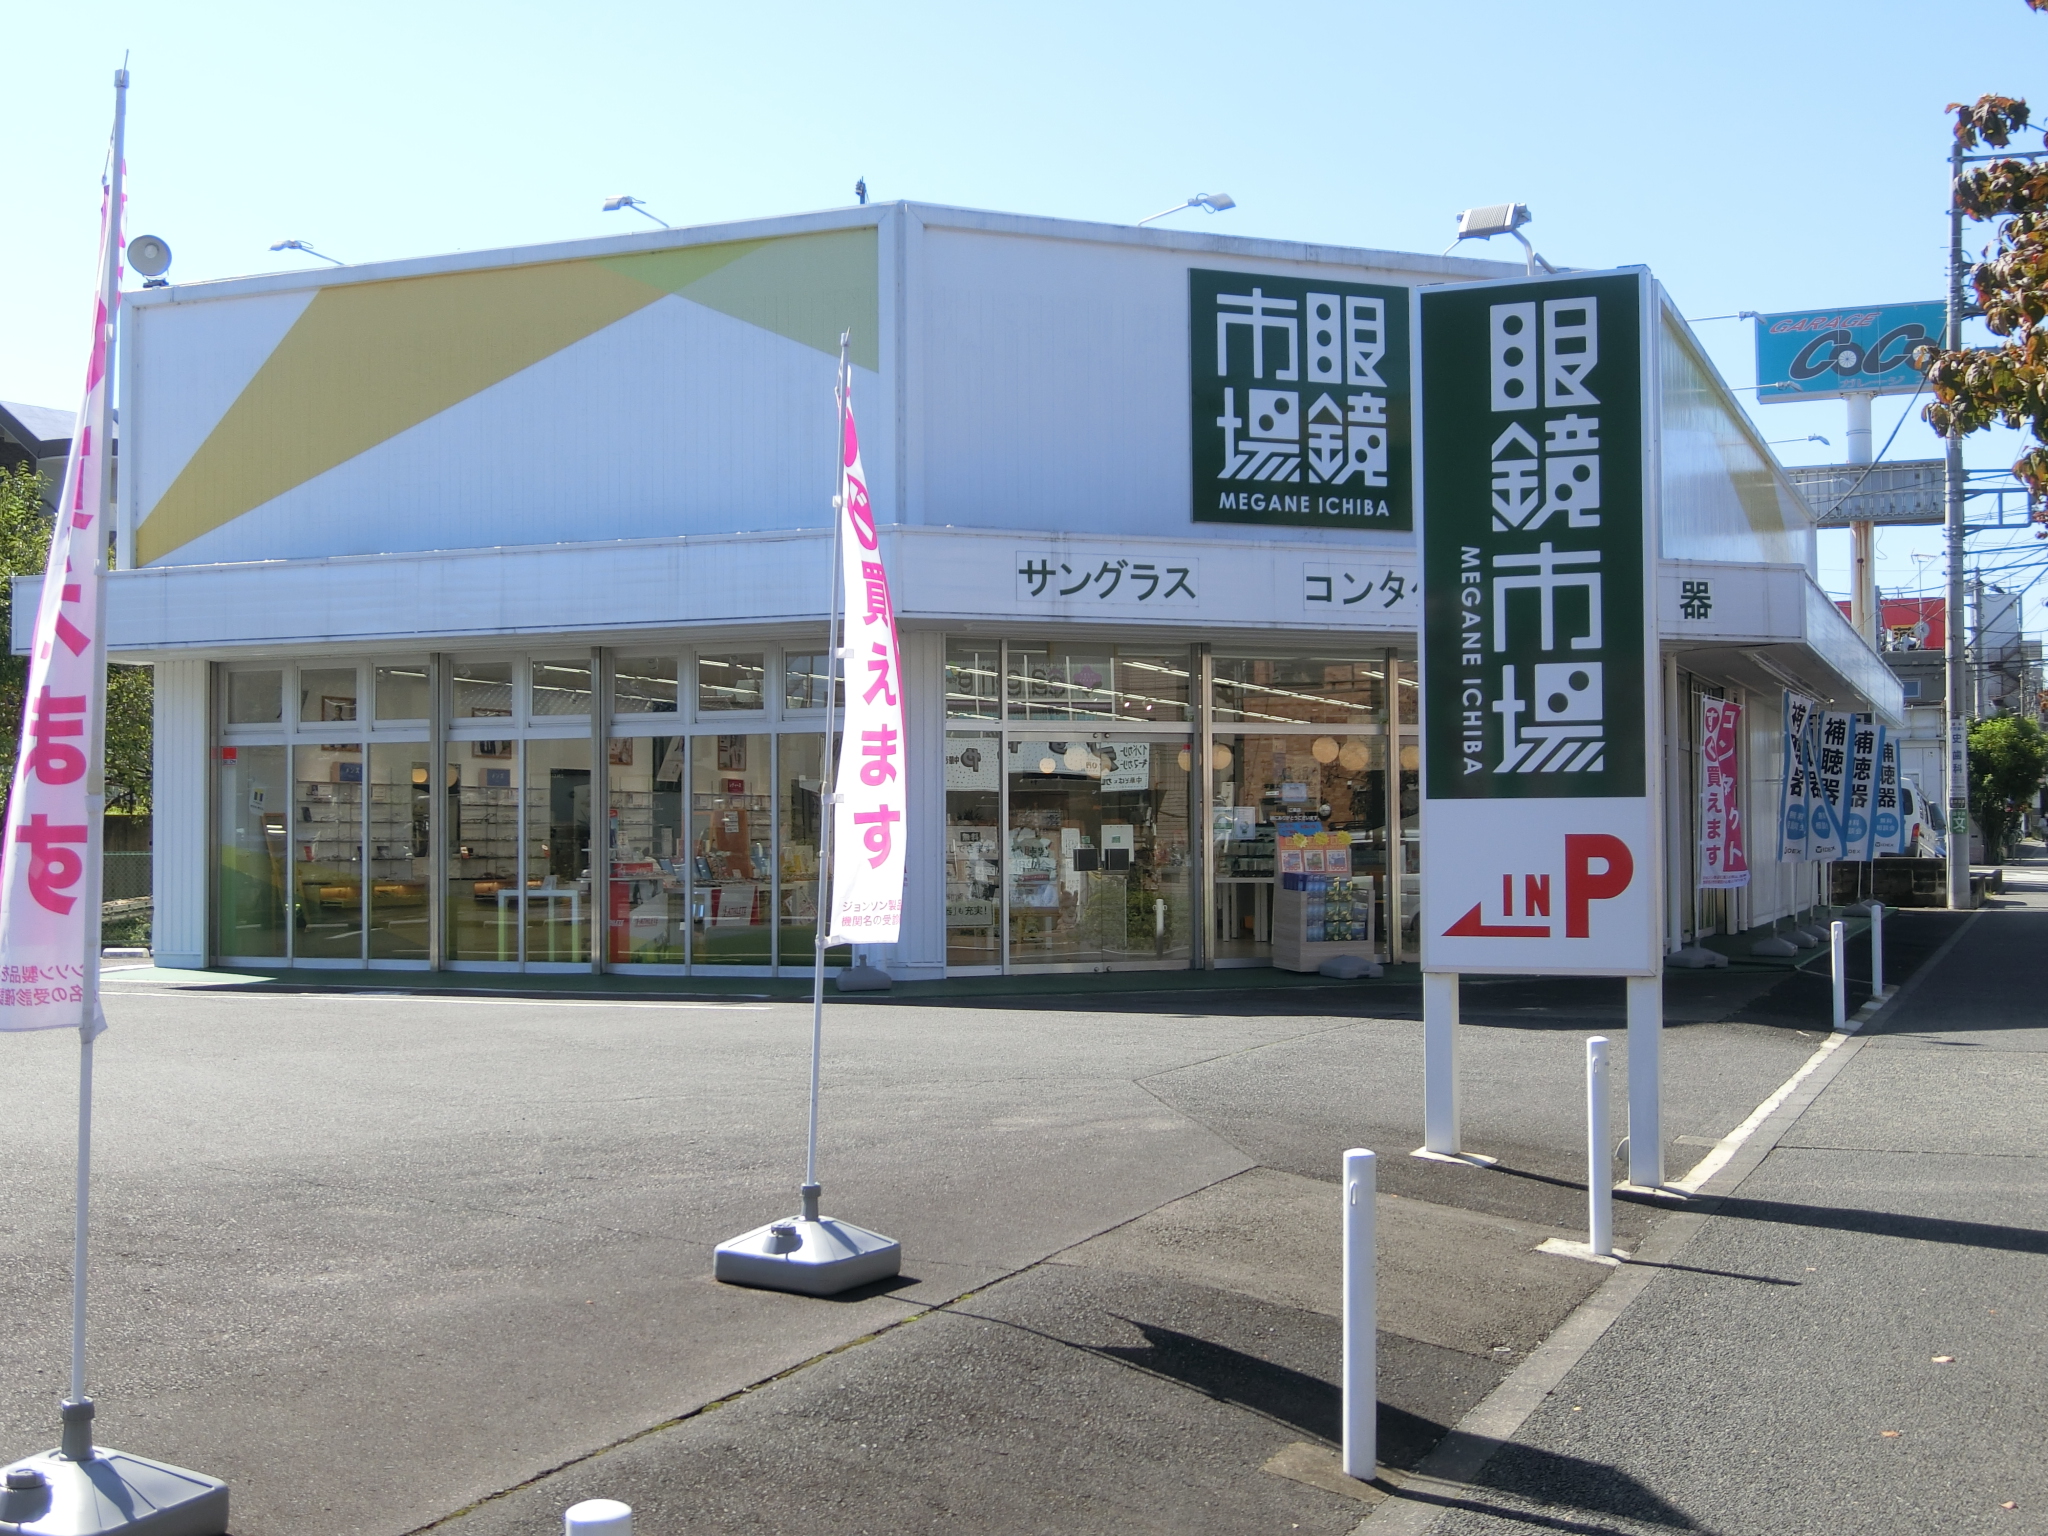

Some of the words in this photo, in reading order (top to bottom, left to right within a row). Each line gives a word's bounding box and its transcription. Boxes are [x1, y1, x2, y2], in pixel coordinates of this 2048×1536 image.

[1770, 312, 1882, 334] GARAGE
[1218, 491, 1310, 513] MEGANE
[1317, 494, 1390, 517] ICHIBA
[1489, 296, 1606, 774] 眼鏡市場
[1018, 559, 1196, 601] サングラス
[1305, 570, 1418, 608] コンタ
[1680, 580, 1713, 620] 器
[1461, 546, 1482, 667] MEGANE
[1462, 675, 1483, 775] ICHIBA
[1821, 717, 1847, 805] 補聴器
[1705, 707, 1722, 867] すぐ買えます
[1717, 711, 1743, 866] コンタクト
[961, 832, 981, 842] 無料
[1953, 816, 1966, 831] 文
[946, 843, 997, 855] しできます。
[1503, 873, 1550, 917] IN
[1564, 833, 1634, 938] P
